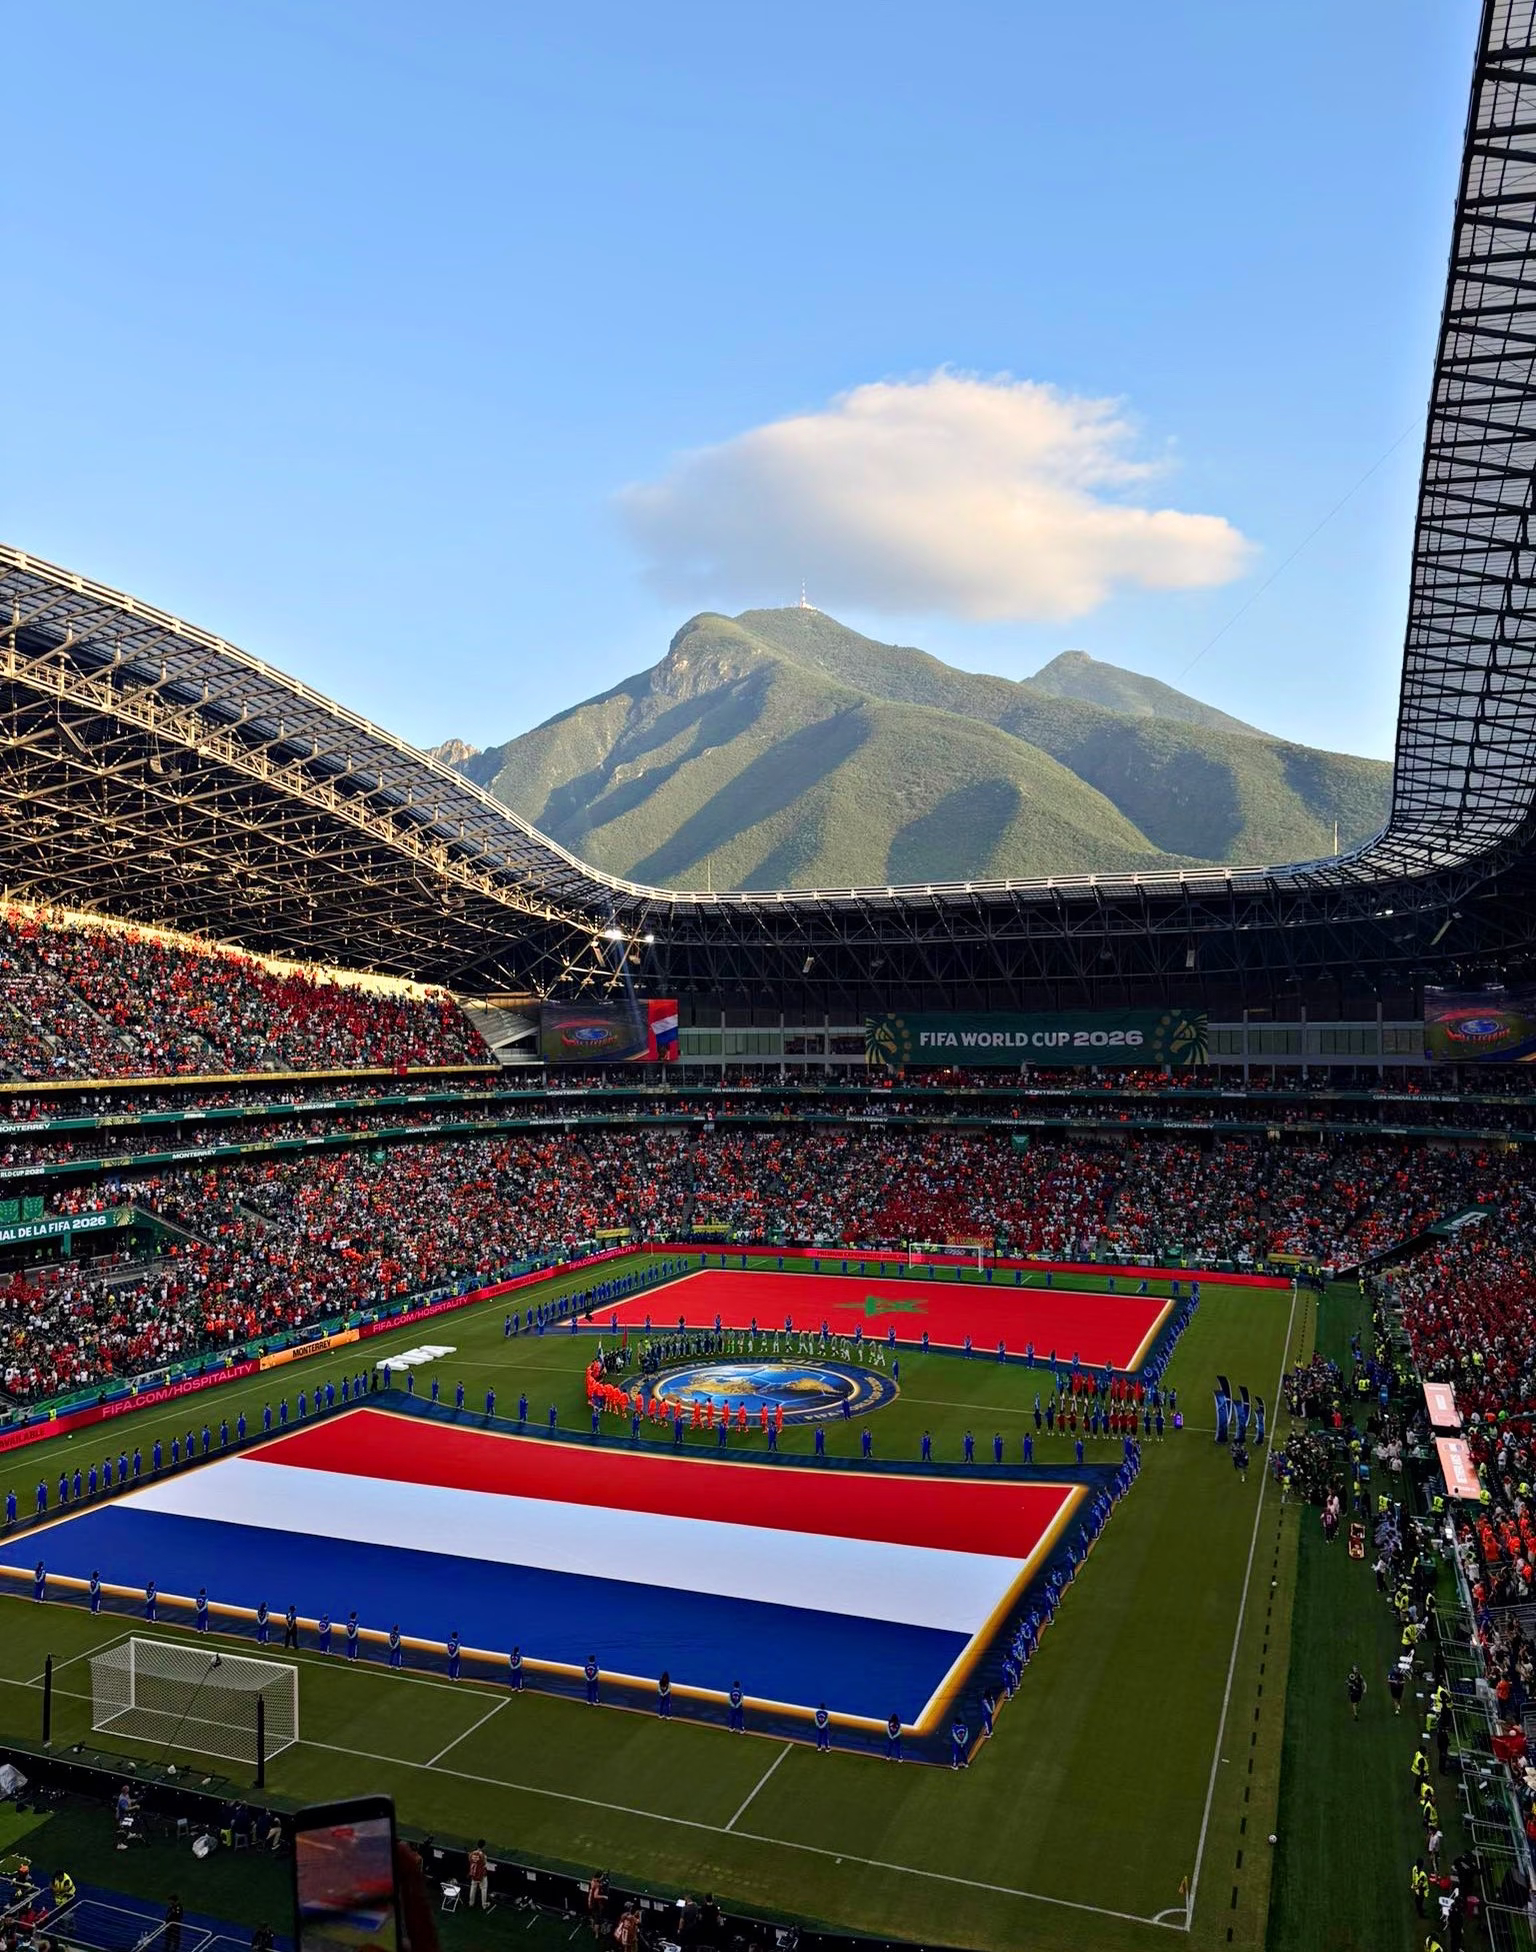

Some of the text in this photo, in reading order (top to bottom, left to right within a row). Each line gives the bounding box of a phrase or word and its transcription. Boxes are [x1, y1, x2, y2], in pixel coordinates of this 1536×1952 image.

[919, 1030, 1144, 1047] FIFA WORLD CUP 2026
[0, 1122, 51, 1133] ONTERREY
[405, 1125, 442, 1134] MONTERREY
[172, 1149, 217, 1159] MONTERREY
[12, 1169, 25, 1178] CUP
[24, 1167, 46, 1177] 2026
[18, 1226, 32, 1239] DE
[33, 1223, 47, 1236] LA
[48, 1220, 71, 1234] FIFA
[72, 1215, 107, 1230] 2026
[372, 1296, 469, 1333] FIFA.COM/HOSPITALITY
[292, 1339, 332, 1359] MONTERREY
[101, 1362, 253, 1419] FIFA.COM/HOSPITALITY
